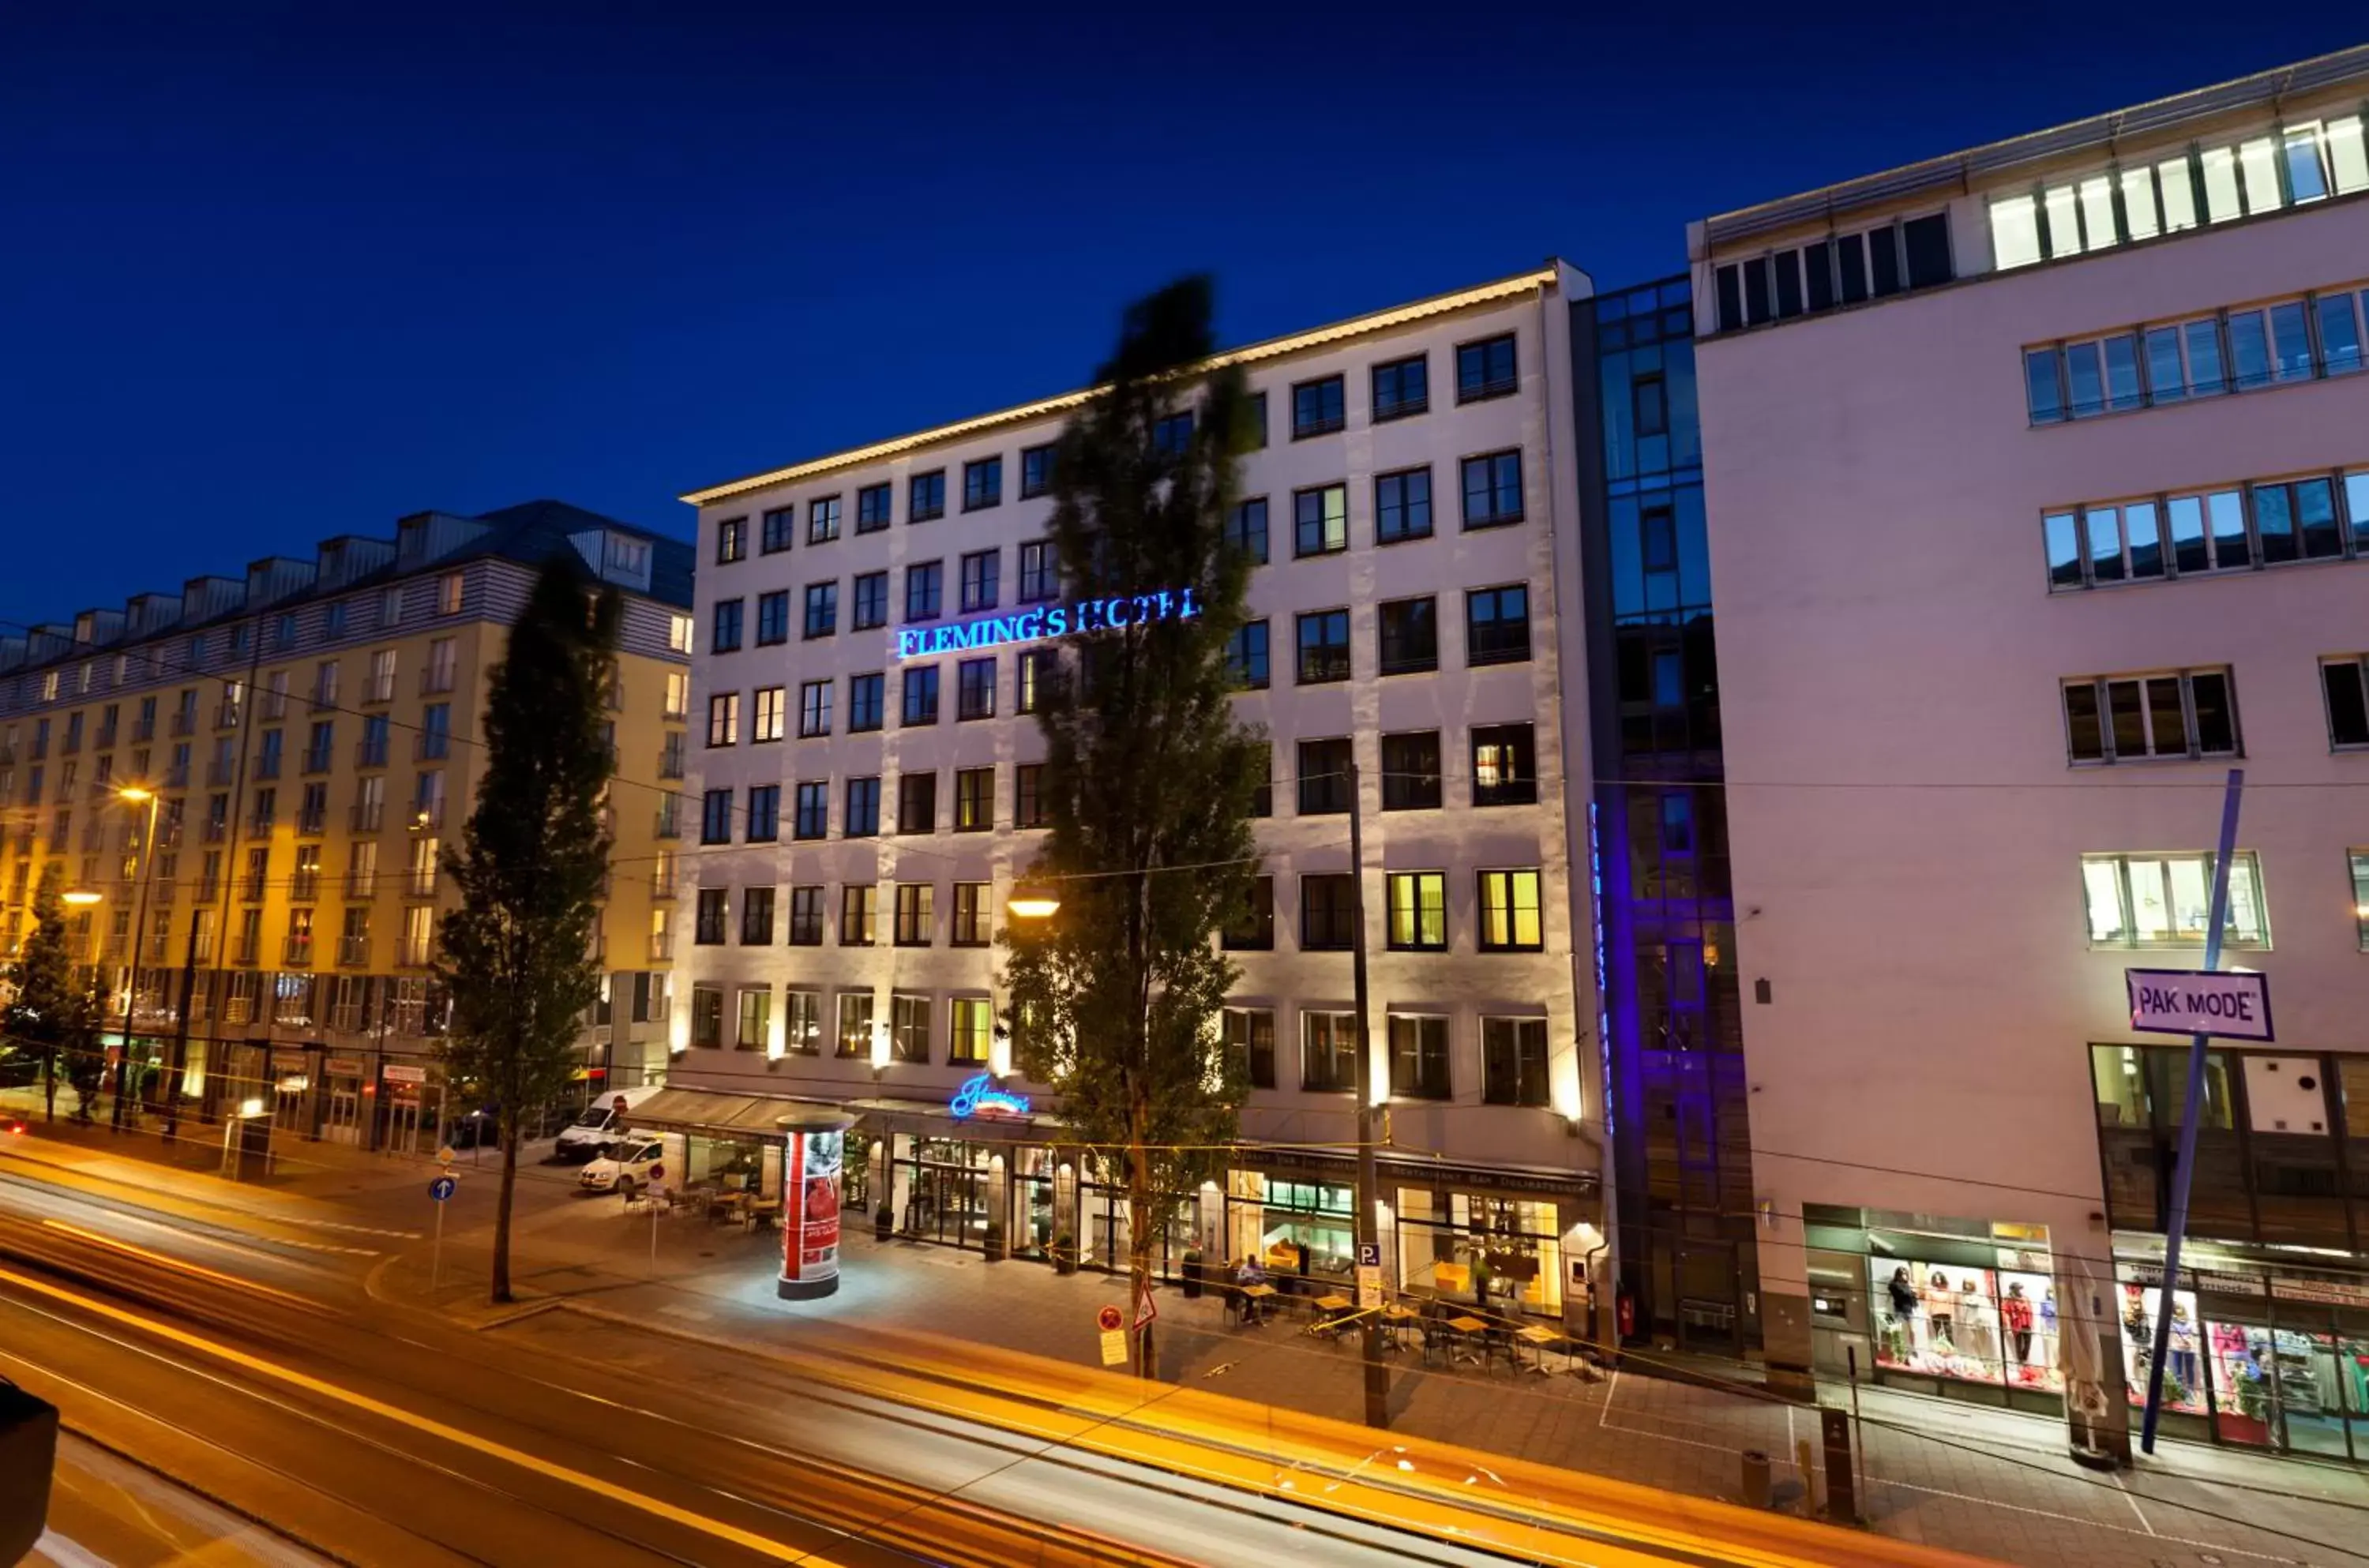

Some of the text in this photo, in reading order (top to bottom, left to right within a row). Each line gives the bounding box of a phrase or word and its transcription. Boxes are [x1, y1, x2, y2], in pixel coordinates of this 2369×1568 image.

[897, 606, 1066, 658] FLEMING'S
[2139, 987, 2254, 1022] PAK MODE
[1361, 1247, 1374, 1264] P
